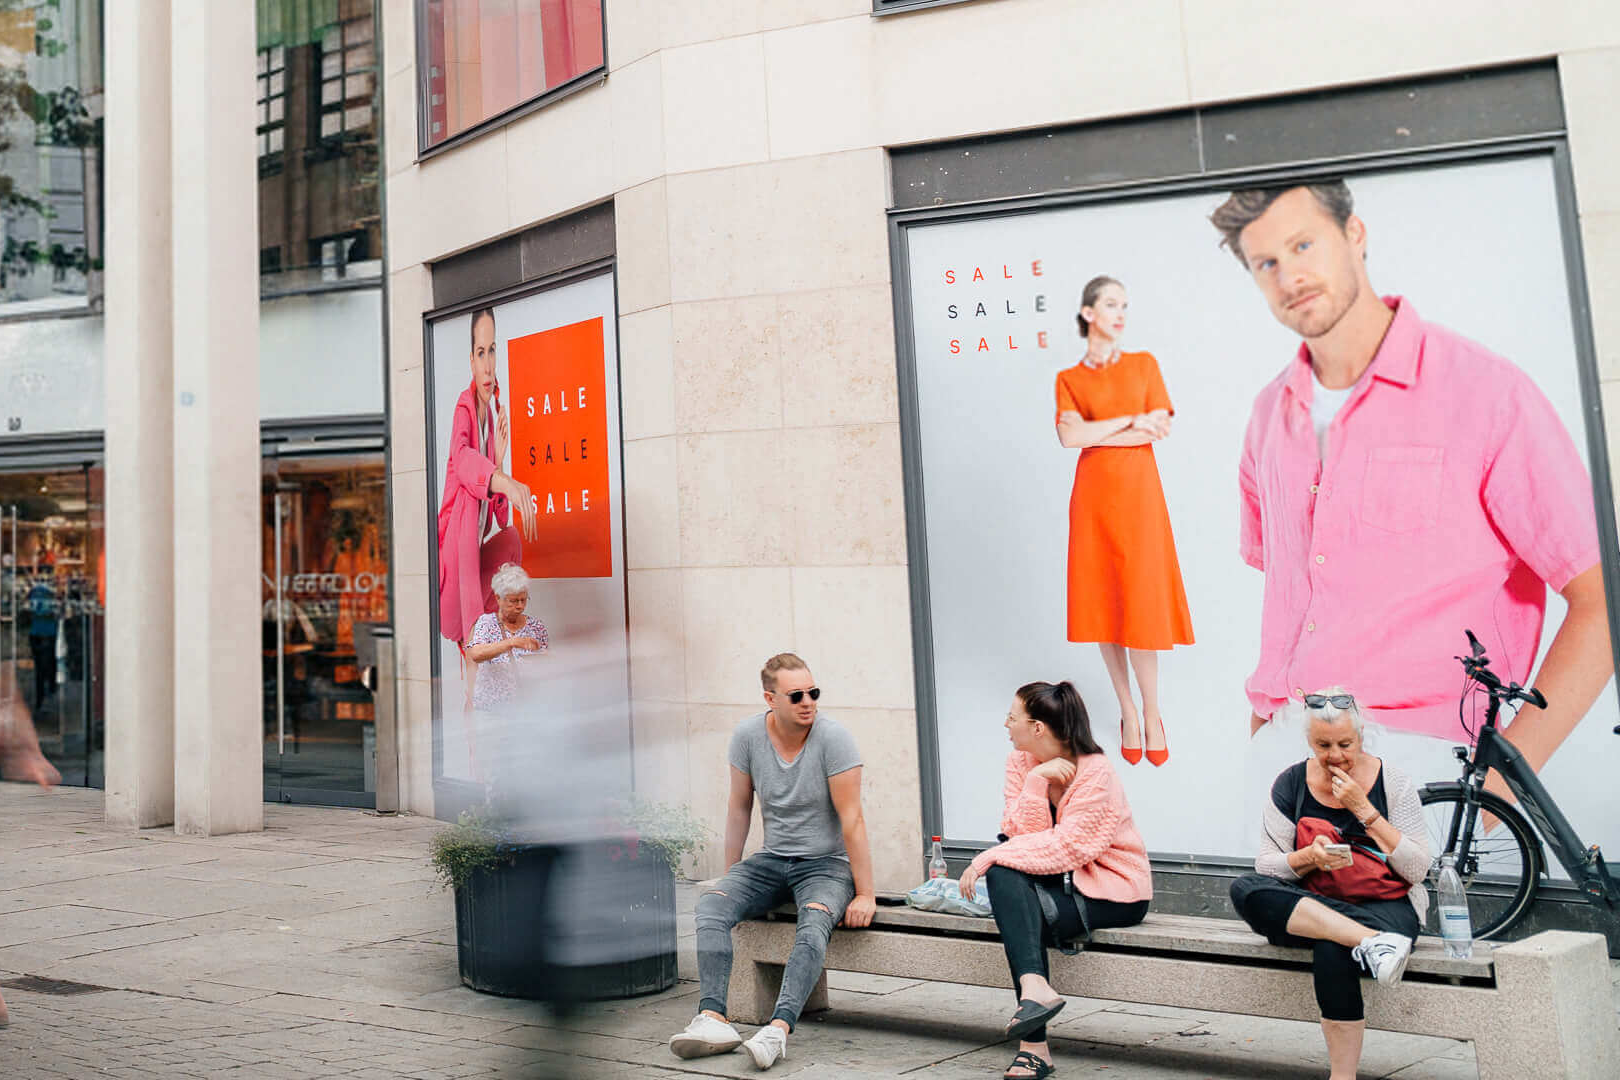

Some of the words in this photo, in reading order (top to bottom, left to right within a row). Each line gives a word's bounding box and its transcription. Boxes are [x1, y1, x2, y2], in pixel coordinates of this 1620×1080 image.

[945, 258, 1044, 285] SALE
[948, 295, 1047, 319] SALE
[950, 331, 1049, 354] SALE
[527, 386, 587, 418] SALE
[529, 438, 588, 466] SALE
[531, 489, 589, 515] SALE
